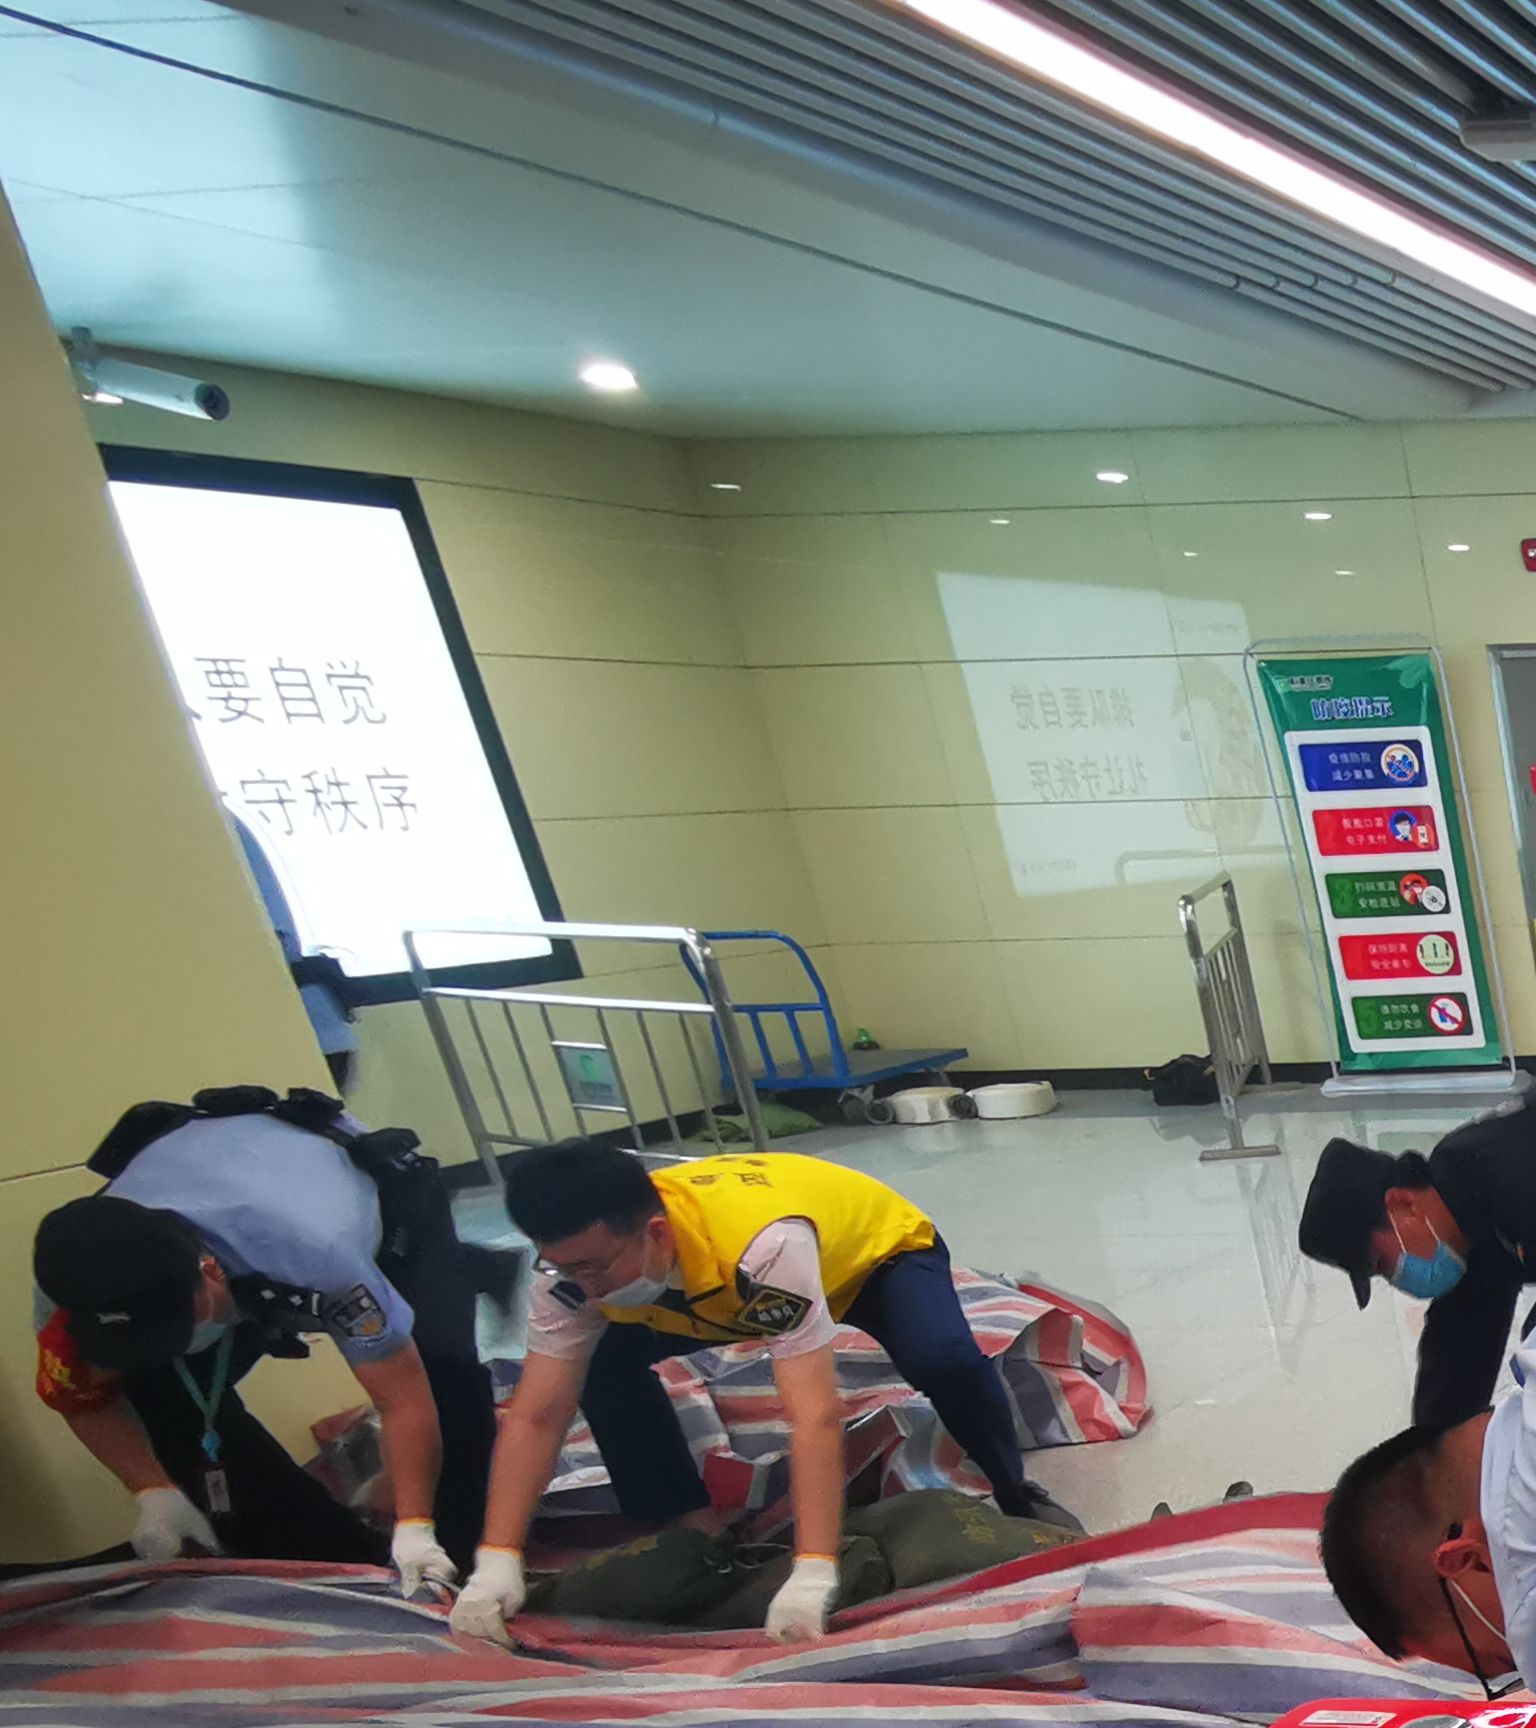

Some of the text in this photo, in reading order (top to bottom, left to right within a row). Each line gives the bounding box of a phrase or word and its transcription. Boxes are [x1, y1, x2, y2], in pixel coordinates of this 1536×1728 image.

[183, 656, 386, 725] 要自觉
[217, 766, 418, 835] 守秩序
